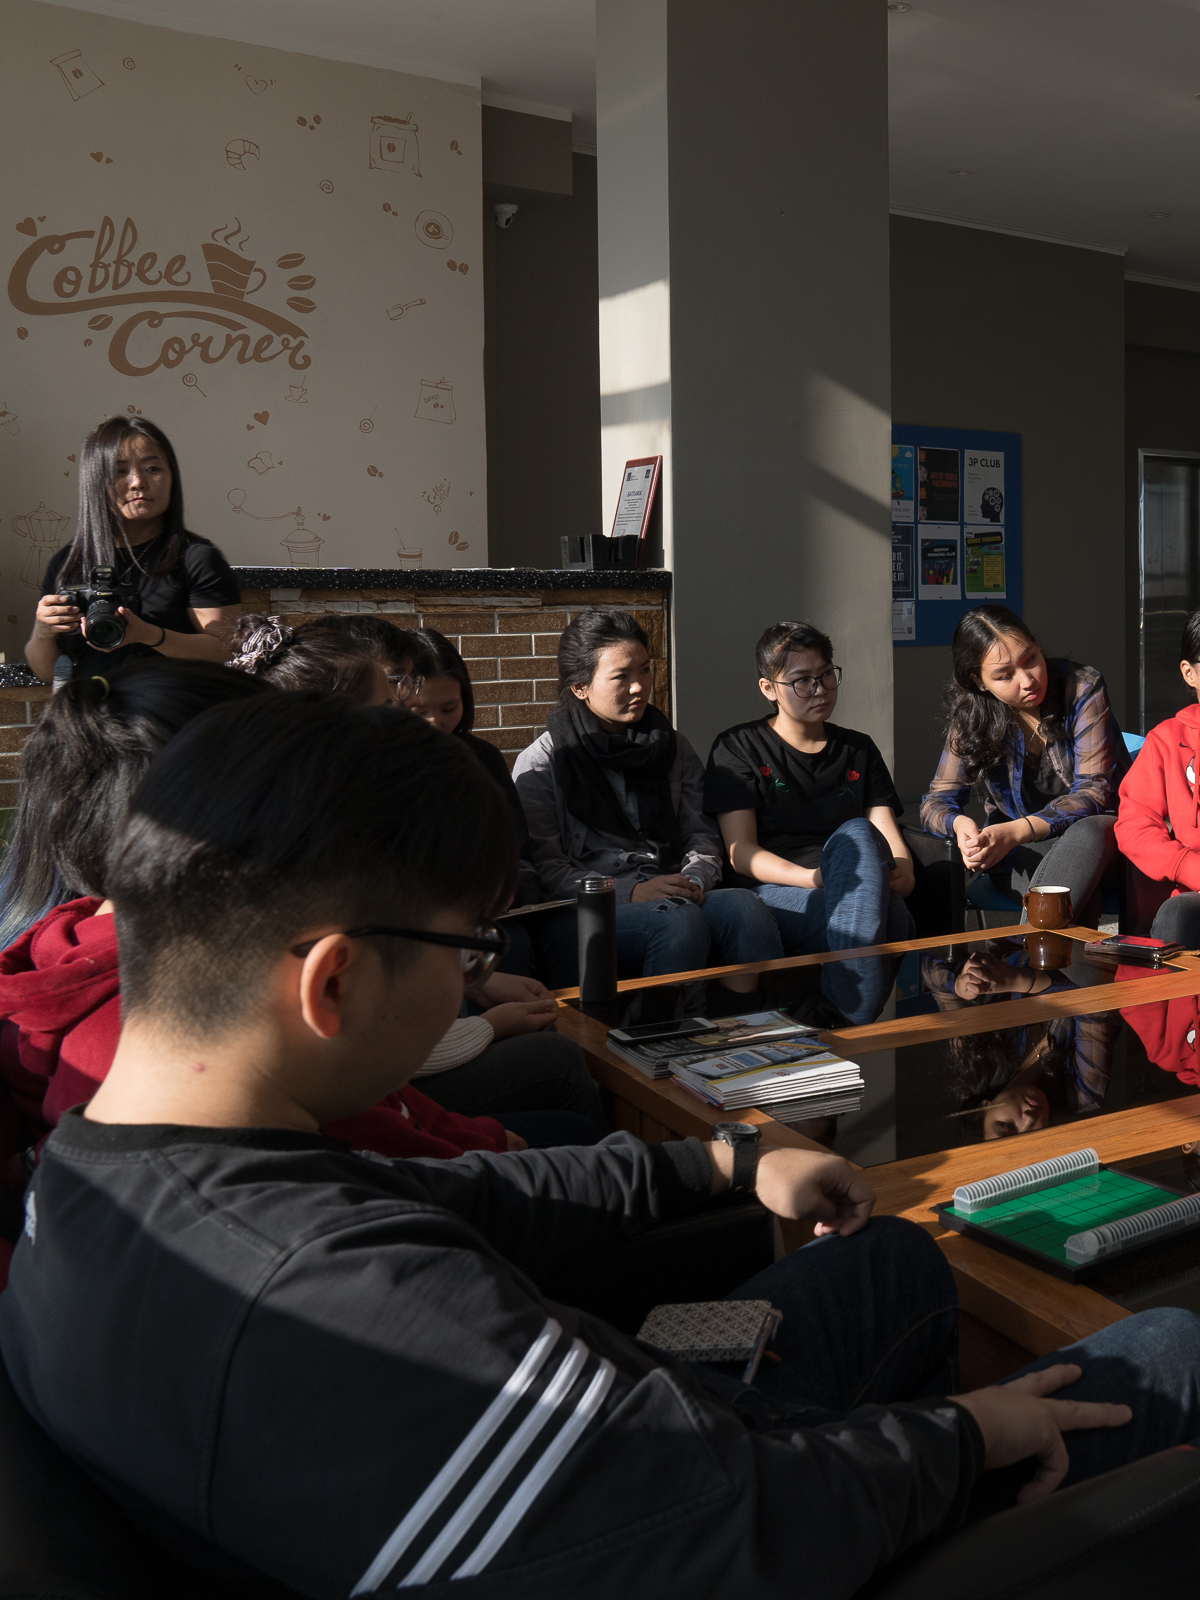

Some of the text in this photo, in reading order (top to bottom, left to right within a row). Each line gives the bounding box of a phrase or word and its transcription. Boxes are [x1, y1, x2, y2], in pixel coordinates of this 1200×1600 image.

[7, 215, 192, 316] Coffee
[108, 310, 312, 377] Corner
[424, 394, 440, 404] COFFEE
[968, 458, 1000, 468] 3P CLUB
